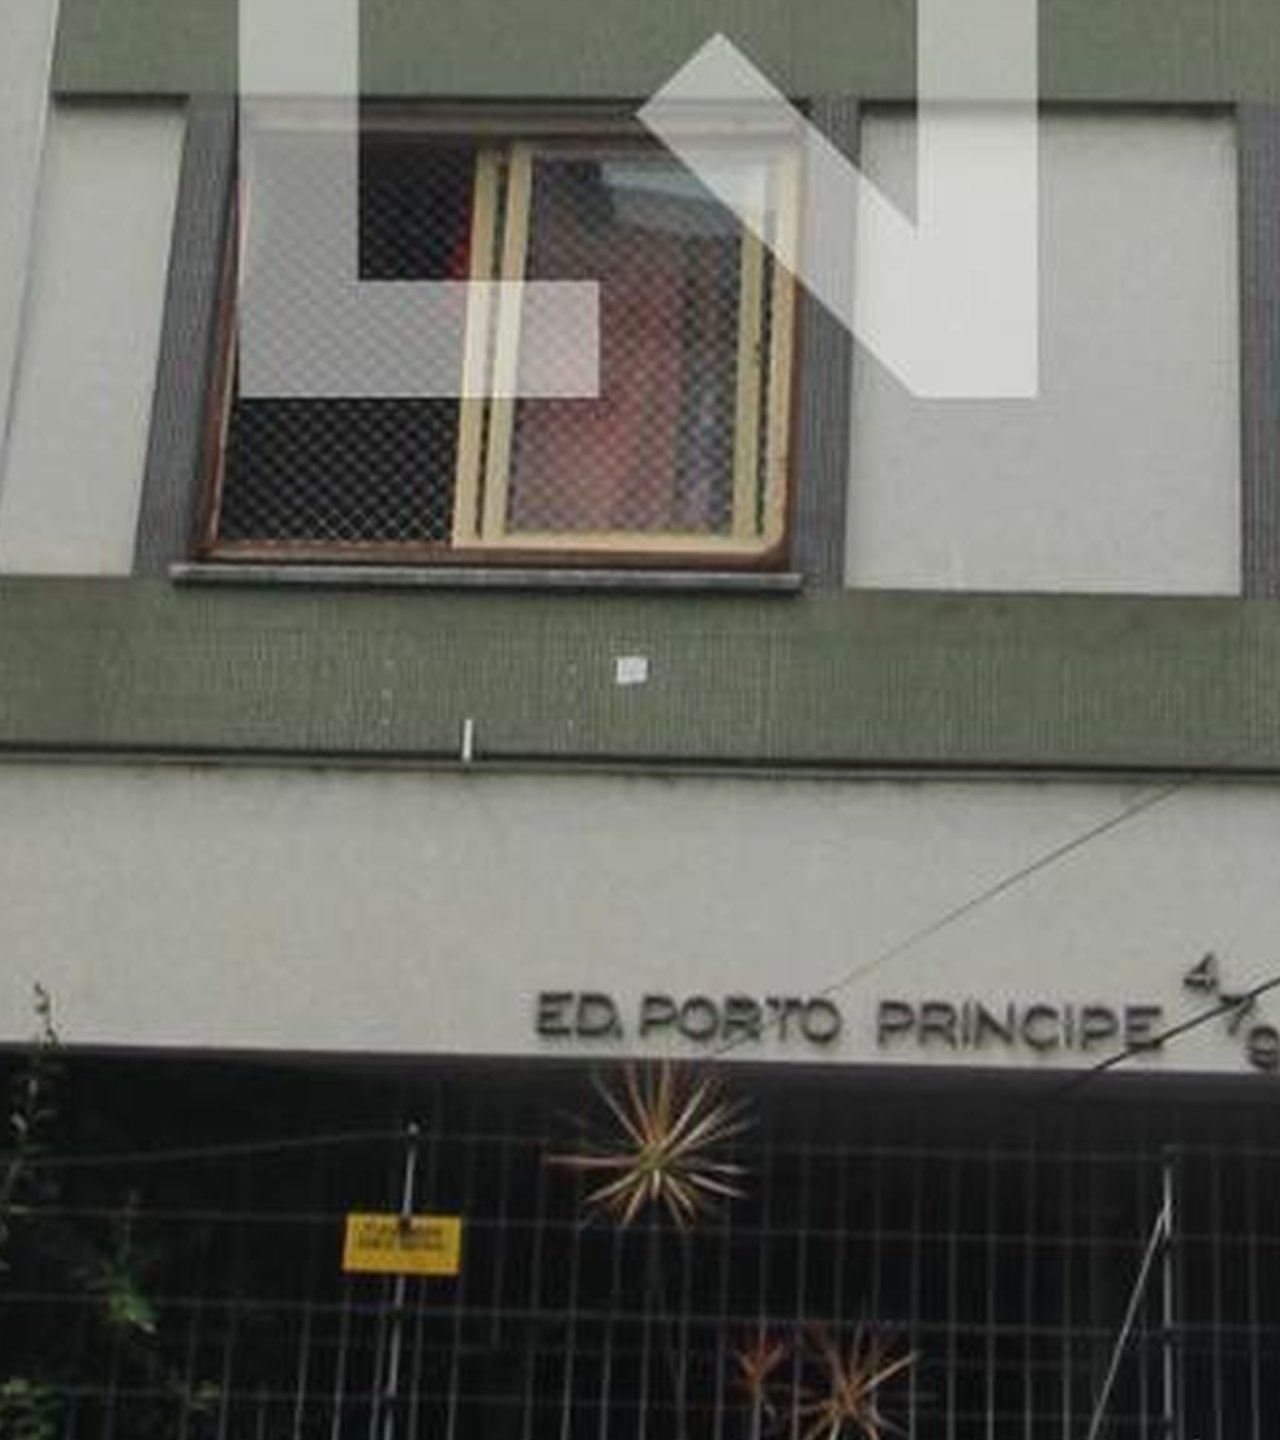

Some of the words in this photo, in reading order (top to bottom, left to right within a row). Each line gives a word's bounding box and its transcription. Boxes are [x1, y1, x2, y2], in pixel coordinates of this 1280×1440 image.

[536, 991, 623, 1039] ED.
[639, 993, 842, 1044] PORTO
[876, 1000, 1163, 1051] PRINCIPE
